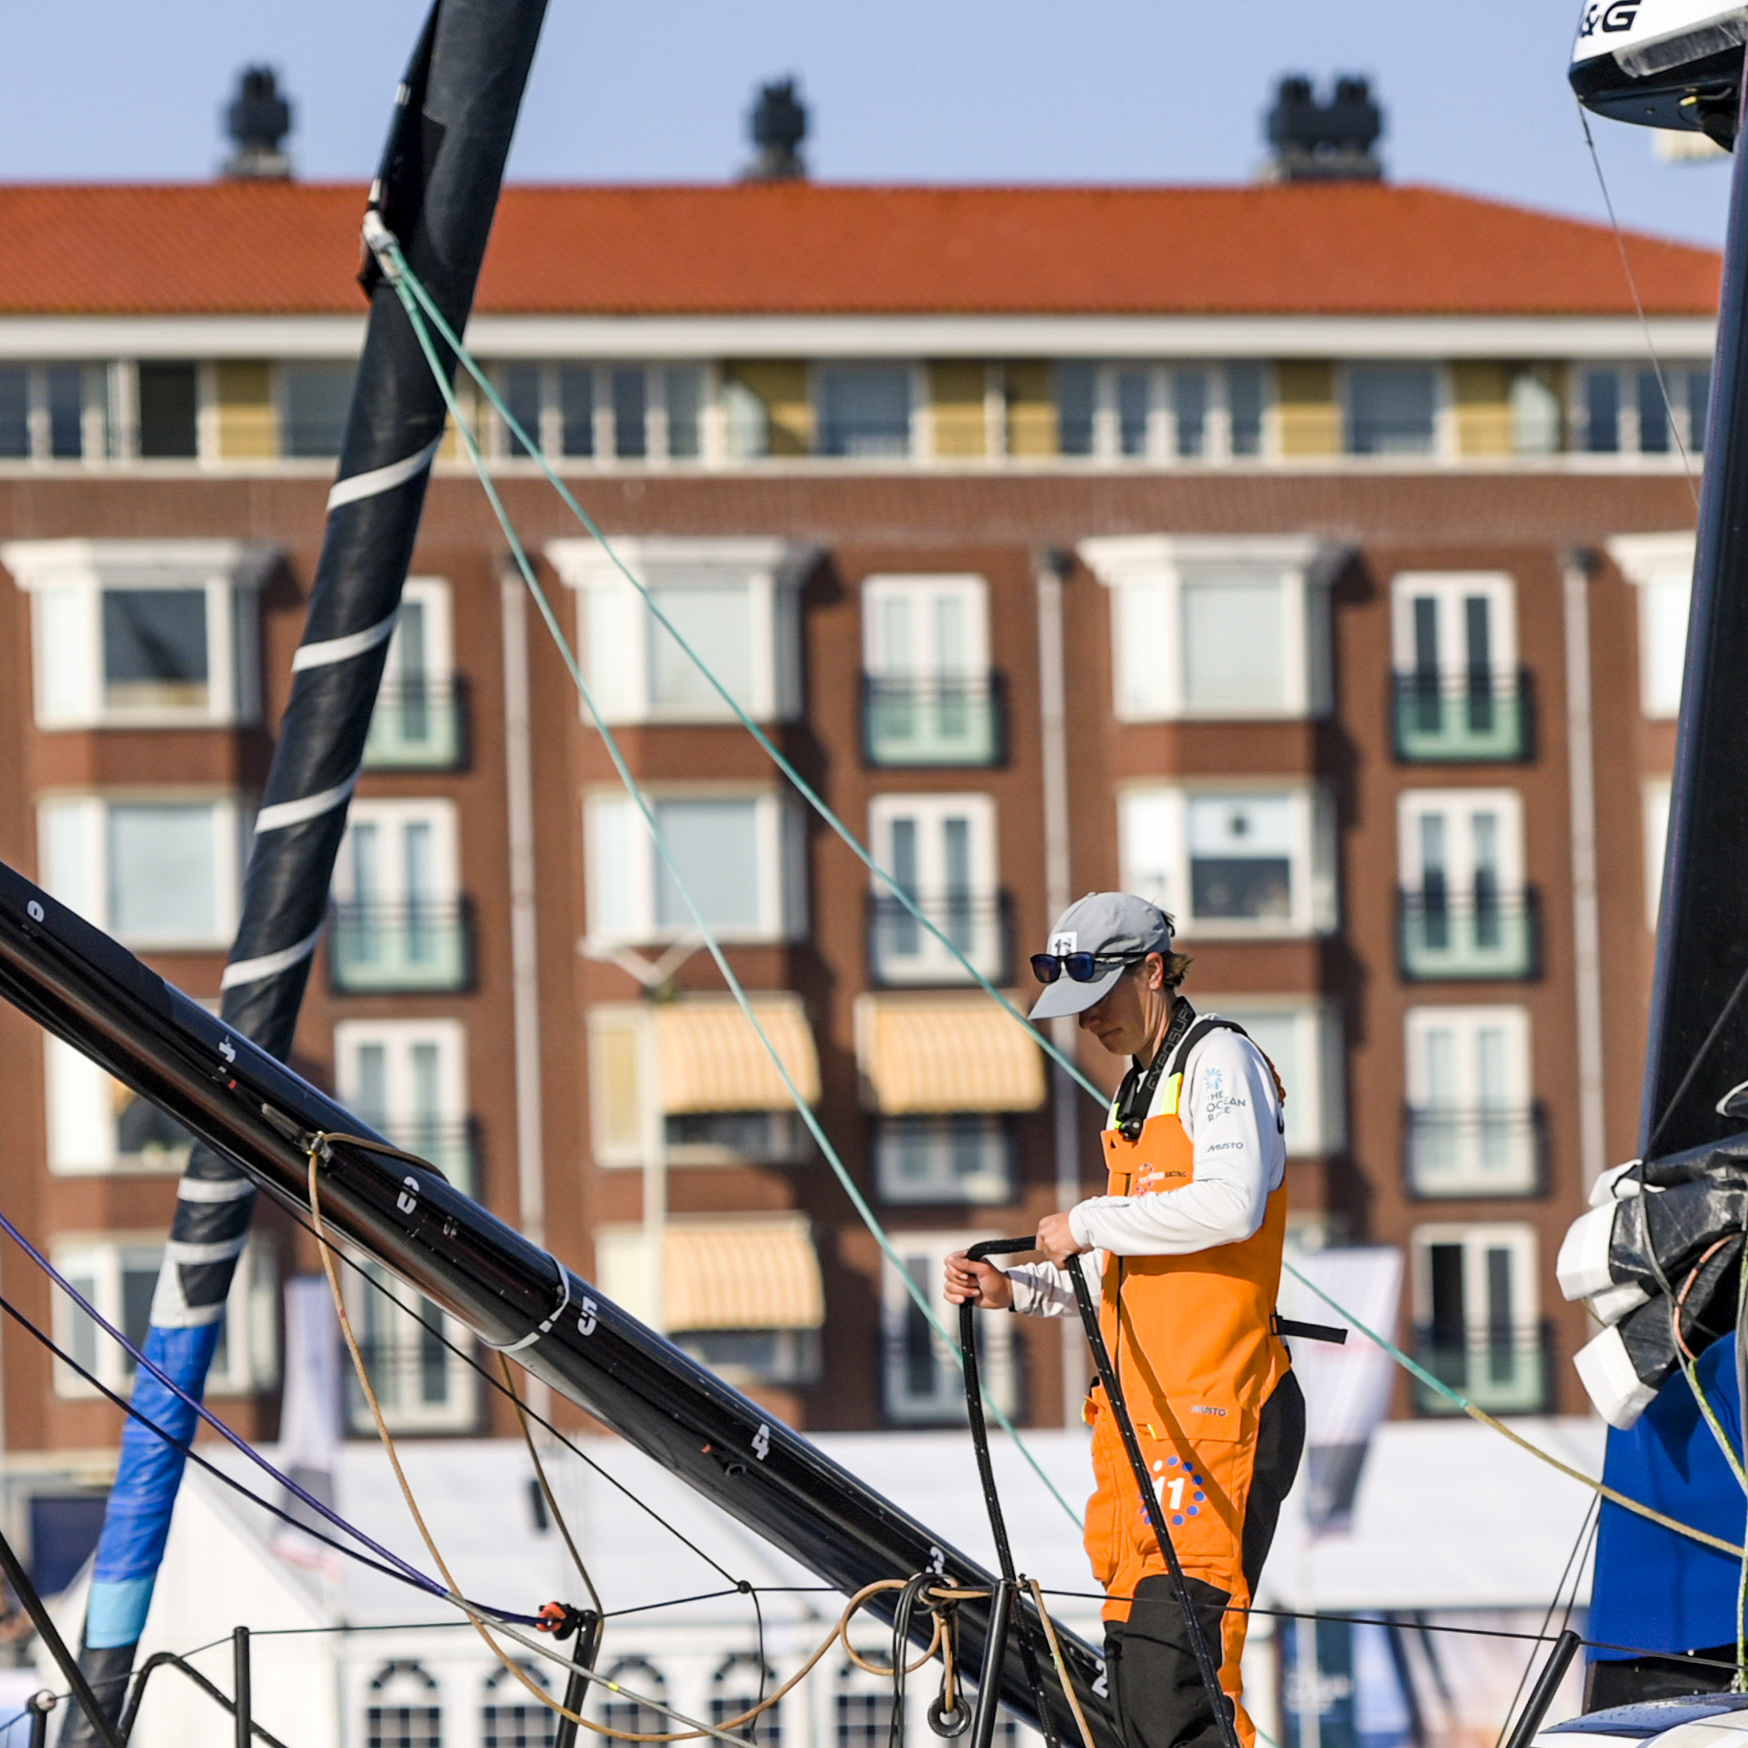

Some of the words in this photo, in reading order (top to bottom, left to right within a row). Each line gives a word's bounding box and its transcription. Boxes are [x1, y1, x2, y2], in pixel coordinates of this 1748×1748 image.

[1206, 1142, 1244, 1153] MUSTO
[750, 1423, 771, 1461] 4
[1152, 1476, 1184, 1511] 11
